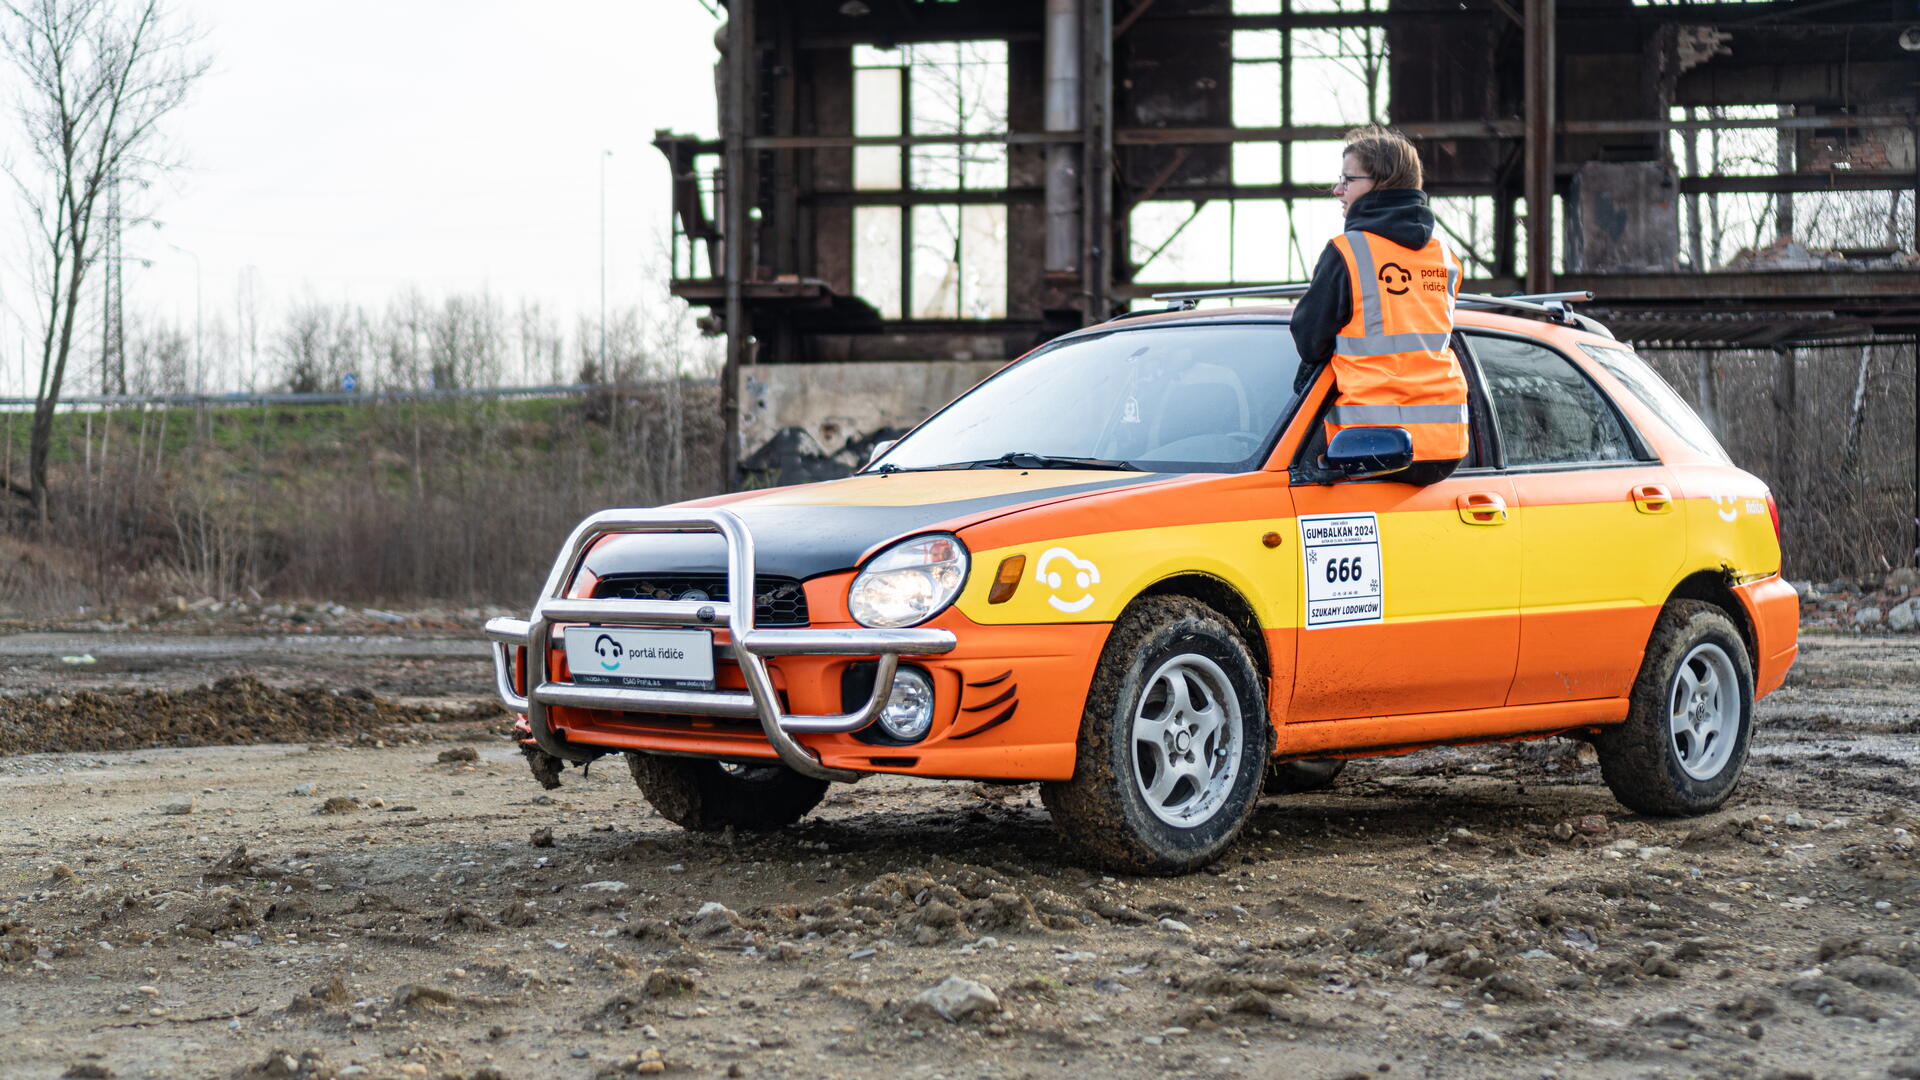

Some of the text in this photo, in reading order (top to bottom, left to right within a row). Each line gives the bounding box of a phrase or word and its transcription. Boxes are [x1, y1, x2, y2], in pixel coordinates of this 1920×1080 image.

[1421, 268, 1447, 279] portál
[1306, 525, 1374, 539] GUMBALKAN 2024
[1326, 556, 1363, 583] 666
[1311, 601, 1379, 618] SZUKAMY LODOWCÓW
[629, 647, 684, 660] portál řidiče
